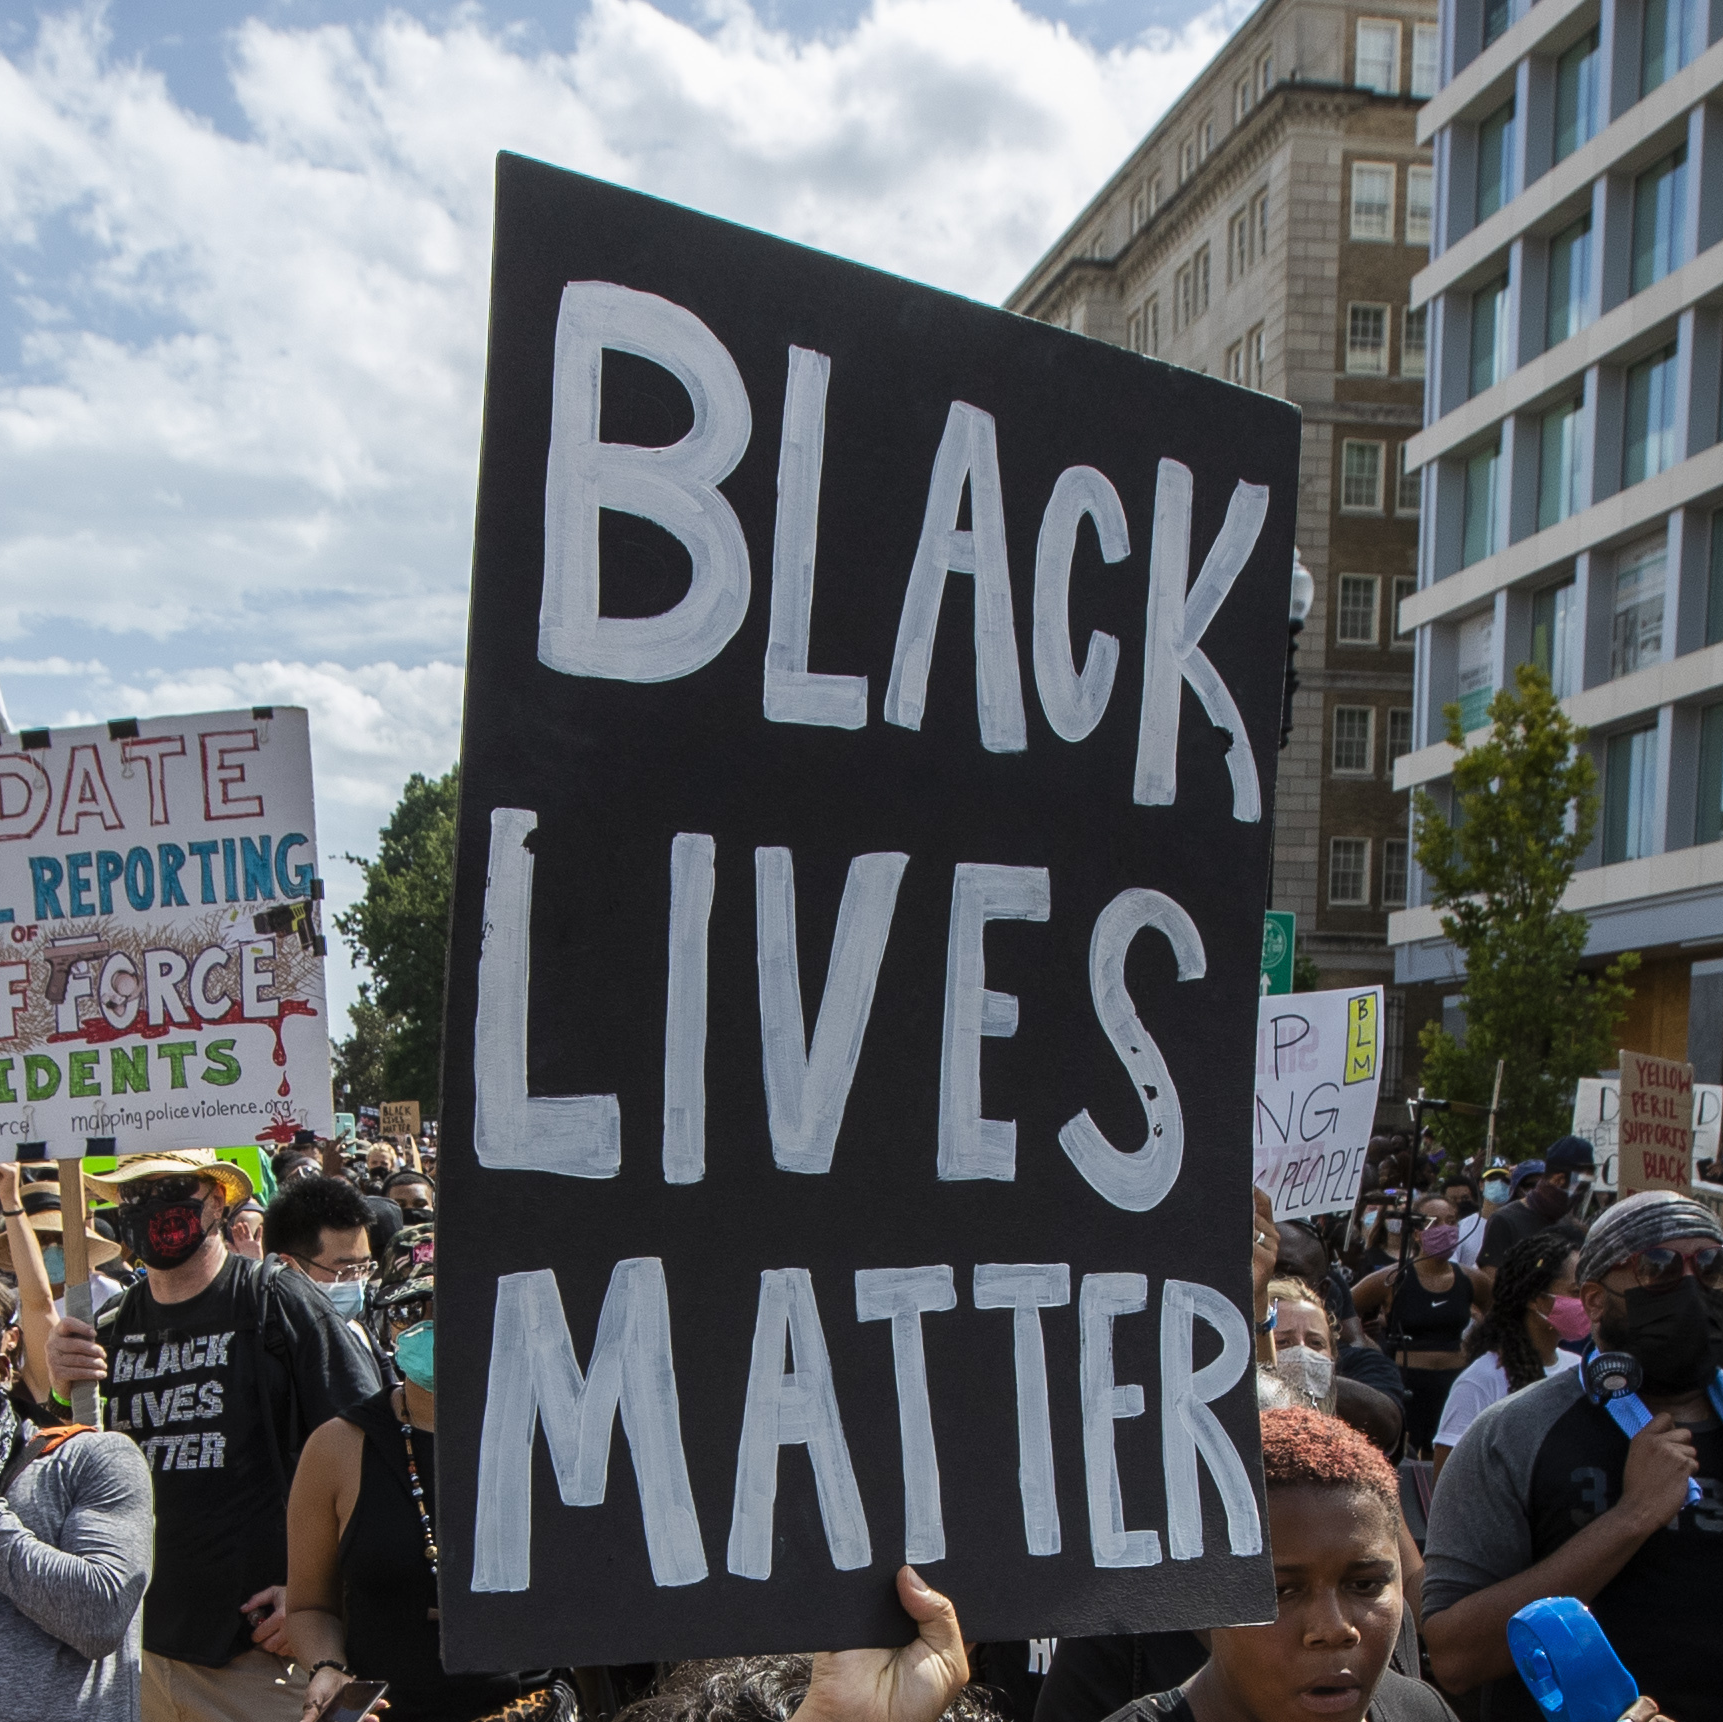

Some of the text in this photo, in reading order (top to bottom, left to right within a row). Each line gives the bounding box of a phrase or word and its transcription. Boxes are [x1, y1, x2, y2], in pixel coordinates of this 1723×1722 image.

[537, 280, 1270, 824] BLACK
[28, 832, 315, 921] REPORTING
[11, 924, 38, 943] OF
[54, 937, 279, 1034] FORCE
[474, 806, 1207, 1213] LIVES
[1353, 998, 1372, 1075] BLM
[1635, 1058, 1693, 1095] YELLOW
[382, 1105, 412, 1117] BLACK
[382, 1115, 405, 1126] LIVES
[1631, 1090, 1679, 1120] PERIL
[382, 1124, 412, 1135] MATTER
[1621, 1119, 1689, 1154] SUPPORTS
[1274, 1146, 1366, 1212] PEOPLE
[1642, 1150, 1688, 1187] BLACK
[113, 1331, 235, 1384] BLACK
[110, 1380, 224, 1431] LIVES
[471, 1256, 1263, 1594] MATTER
[140, 1432, 227, 1471] TTER
